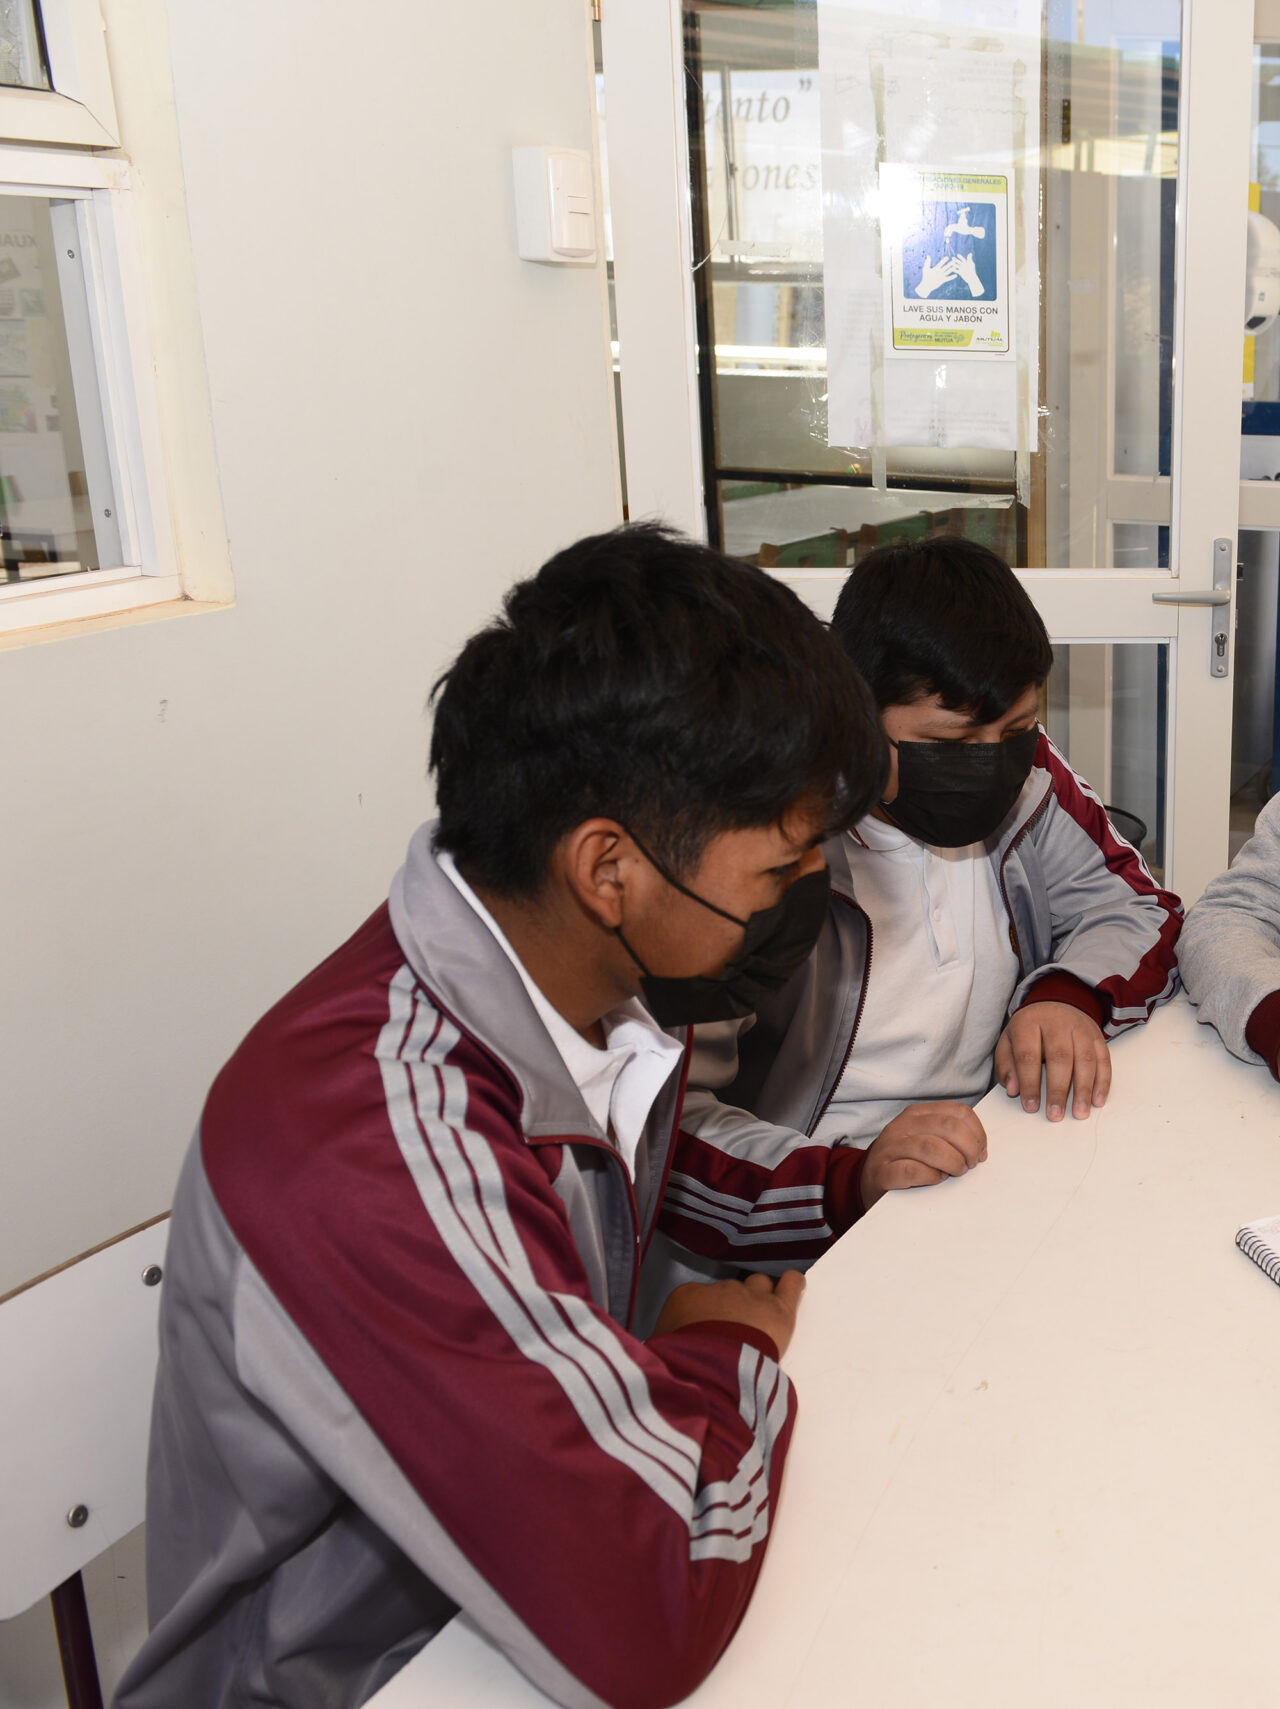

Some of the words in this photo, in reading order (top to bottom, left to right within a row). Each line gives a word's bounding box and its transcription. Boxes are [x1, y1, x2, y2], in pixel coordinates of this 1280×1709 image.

[903, 305, 924, 313] LAVE
[926, 305, 944, 313] SUS
[945, 306, 978, 314] MANOS
[979, 307, 999, 315] CON
[919, 314, 944, 322] AGUA
[945, 314, 952, 322] Y
[953, 314, 983, 323] JABÓN
